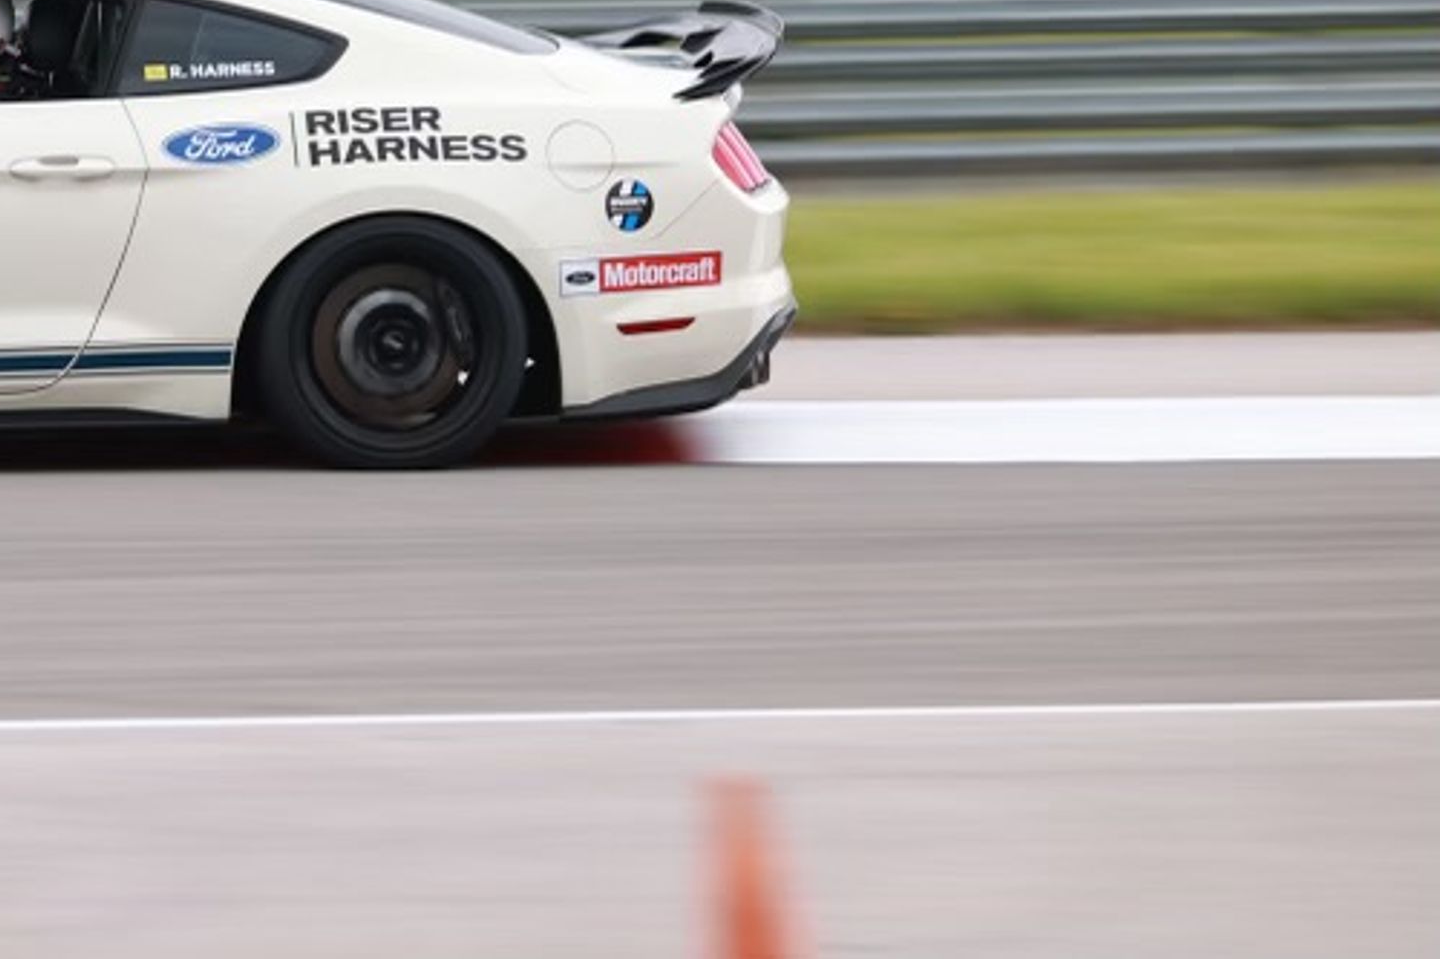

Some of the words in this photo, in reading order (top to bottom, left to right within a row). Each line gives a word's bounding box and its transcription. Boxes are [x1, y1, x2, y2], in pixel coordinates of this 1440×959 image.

[189, 59, 276, 79] HARNESS
[305, 106, 442, 136] RISER
[183, 127, 256, 161] Ford
[308, 135, 528, 167] HARNESS
[602, 255, 715, 288] Motorcraft
